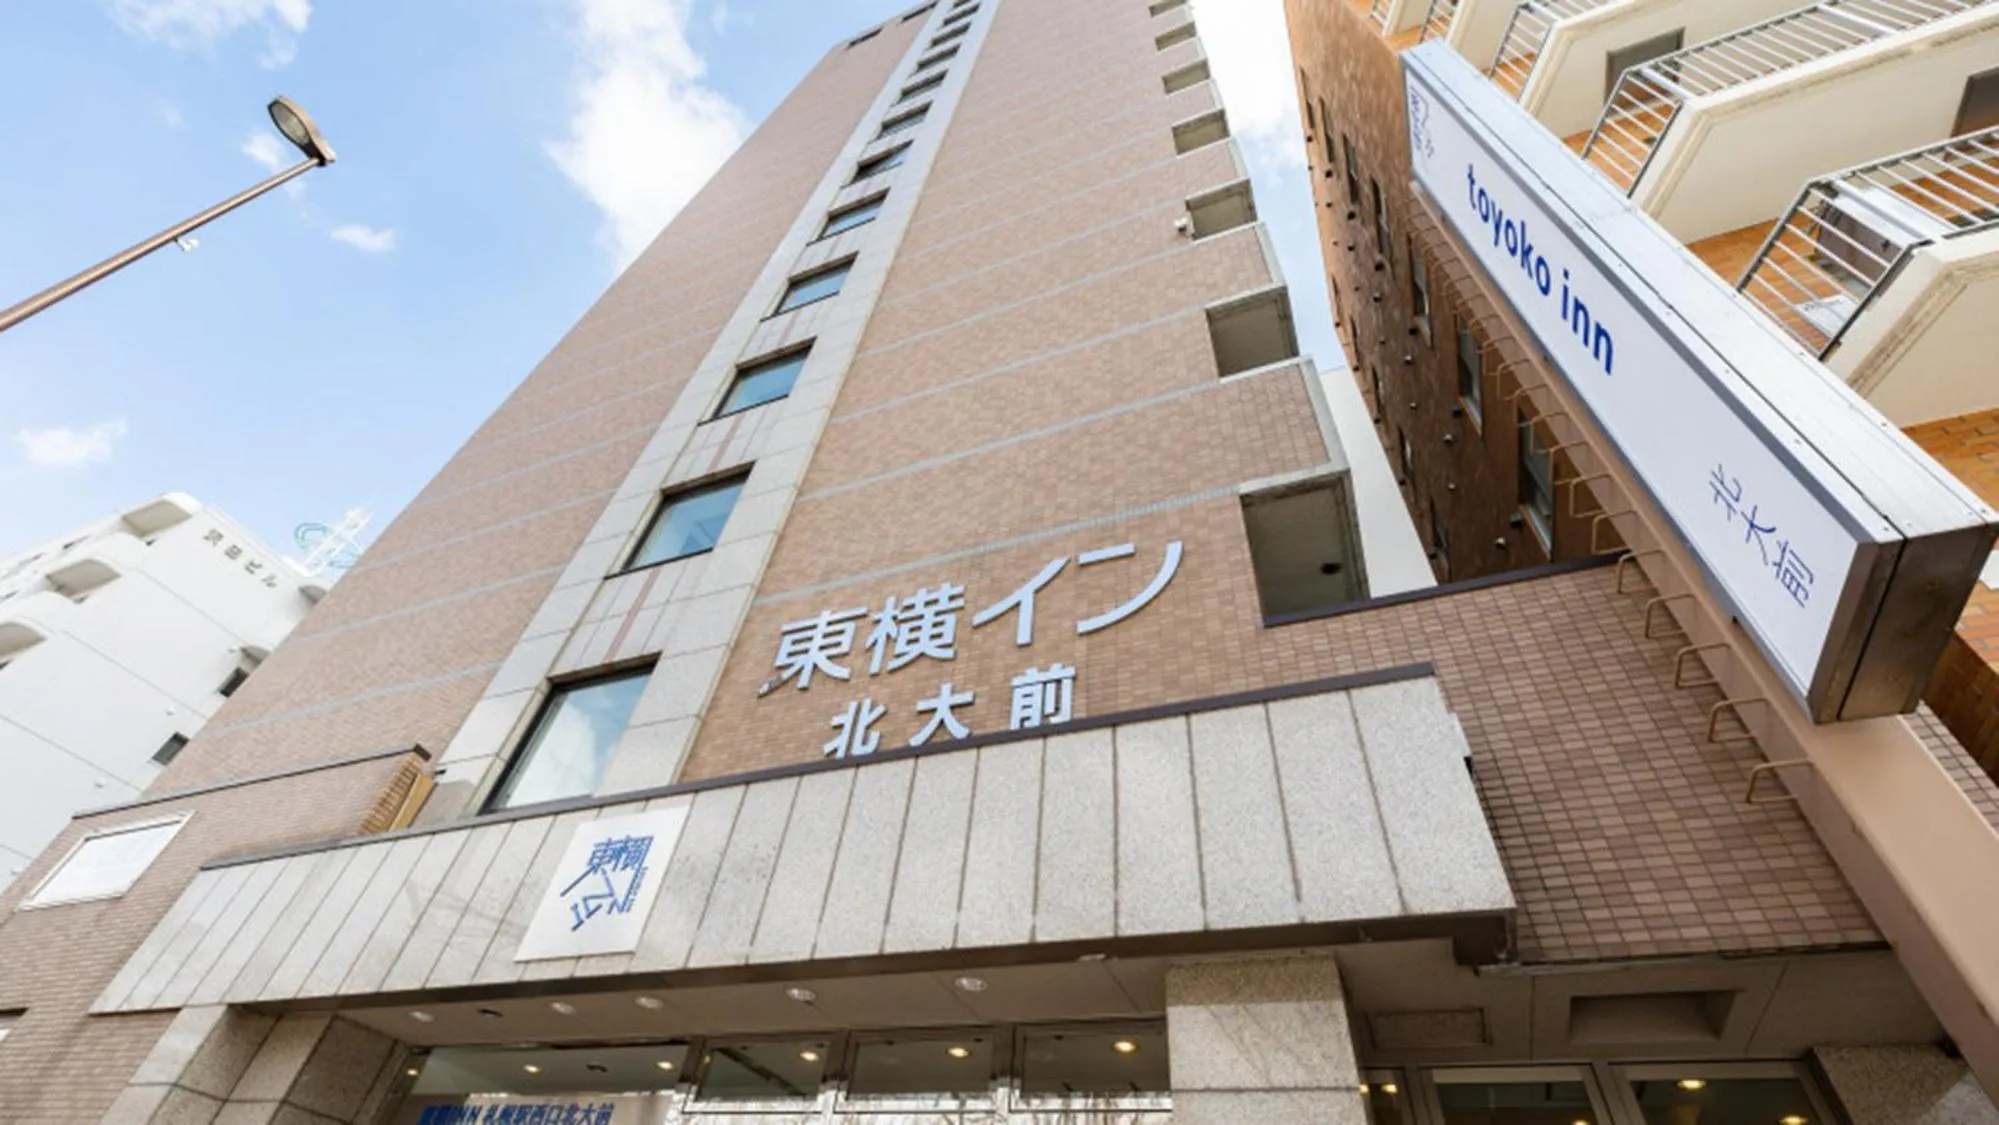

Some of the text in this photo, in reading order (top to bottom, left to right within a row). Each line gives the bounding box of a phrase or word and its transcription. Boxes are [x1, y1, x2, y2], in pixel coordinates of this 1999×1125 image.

[1467, 163, 1614, 375] toyoko inn
[1708, 463, 1815, 610] 北大前
[758, 540, 1184, 699] 東横イン
[822, 661, 1077, 760] 北大前
